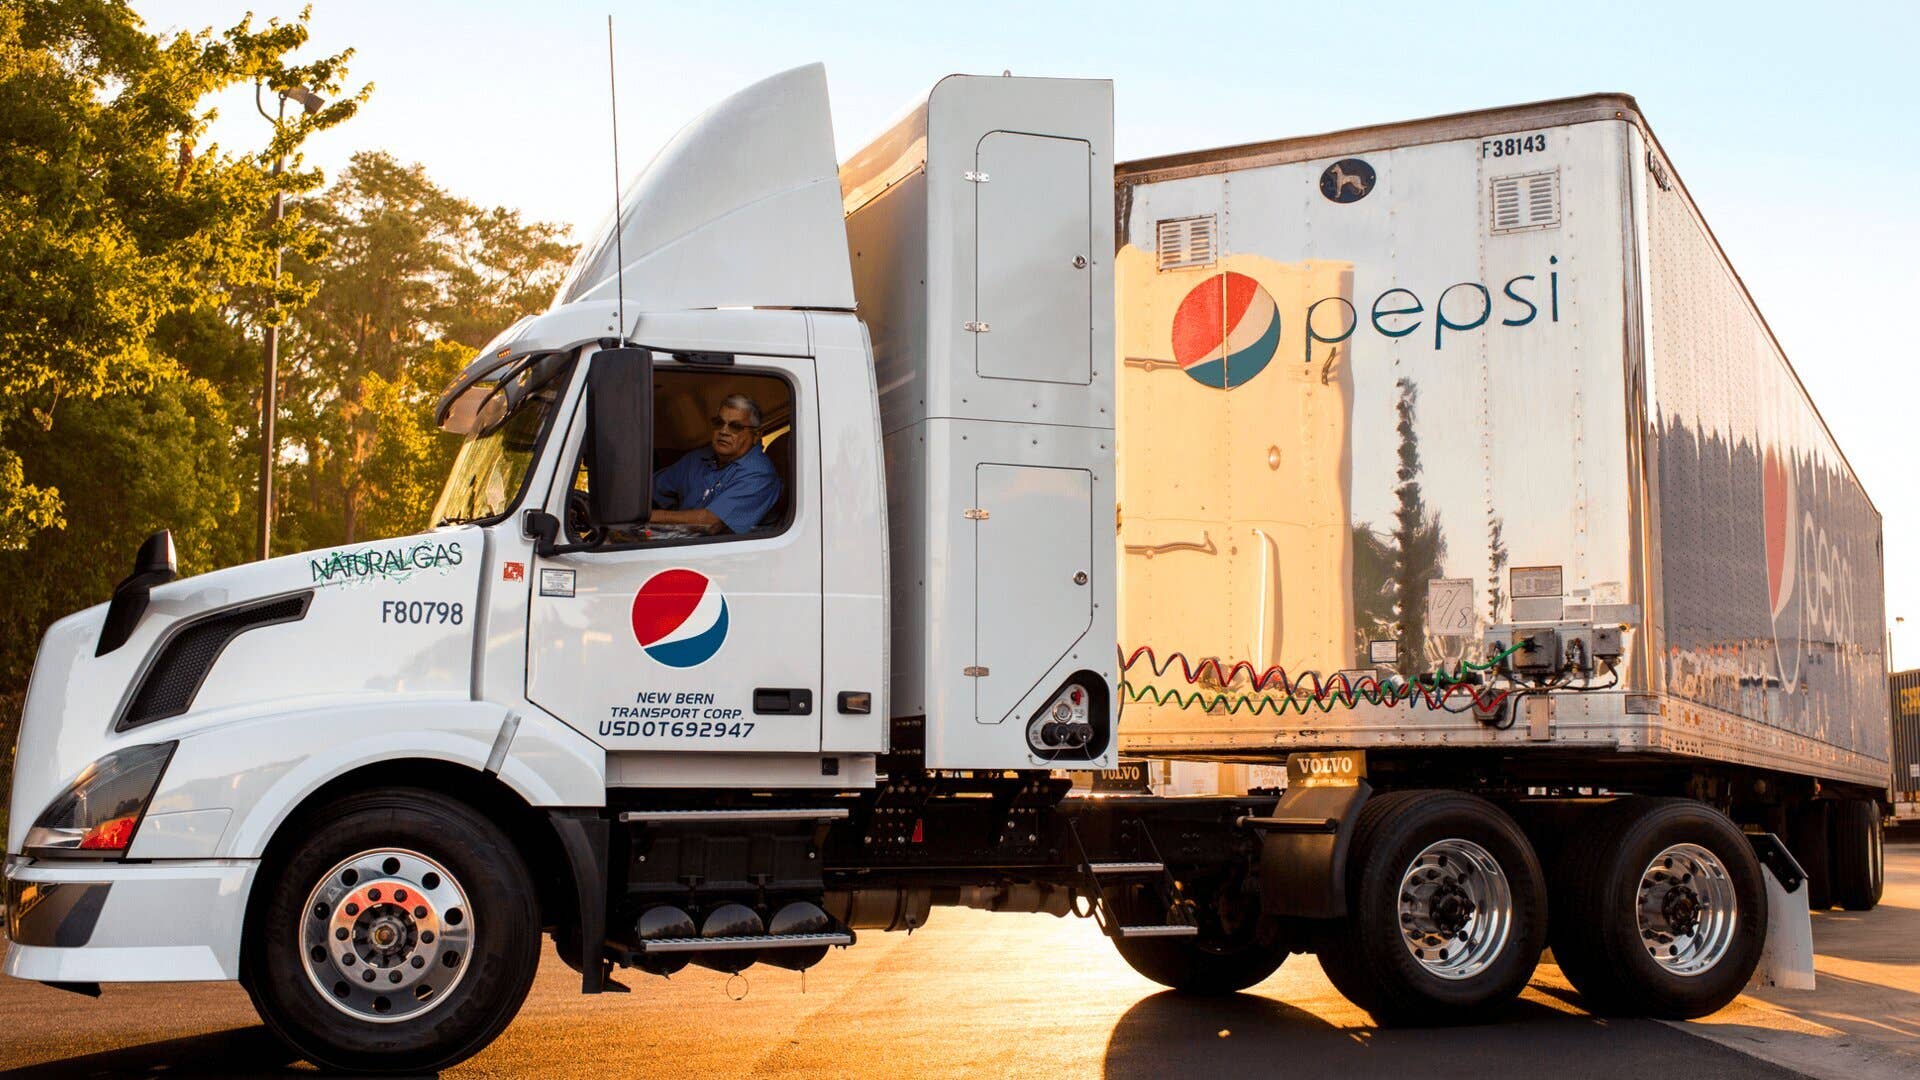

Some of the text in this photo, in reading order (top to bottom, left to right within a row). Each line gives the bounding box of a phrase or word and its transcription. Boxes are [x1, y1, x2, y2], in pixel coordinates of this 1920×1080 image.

[1482, 134, 1546, 159] F38143
[1305, 255, 1559, 362] pepsi
[311, 542, 463, 582] NATURAL GAS
[382, 601, 463, 625] F80798
[636, 692, 714, 704] NEW BERN
[611, 707, 744, 720] TRANSPORT CORP.
[599, 721, 755, 738] USDOT692947
[1101, 766, 1140, 780] VOLVO
[1297, 757, 1353, 773] VOLVO
